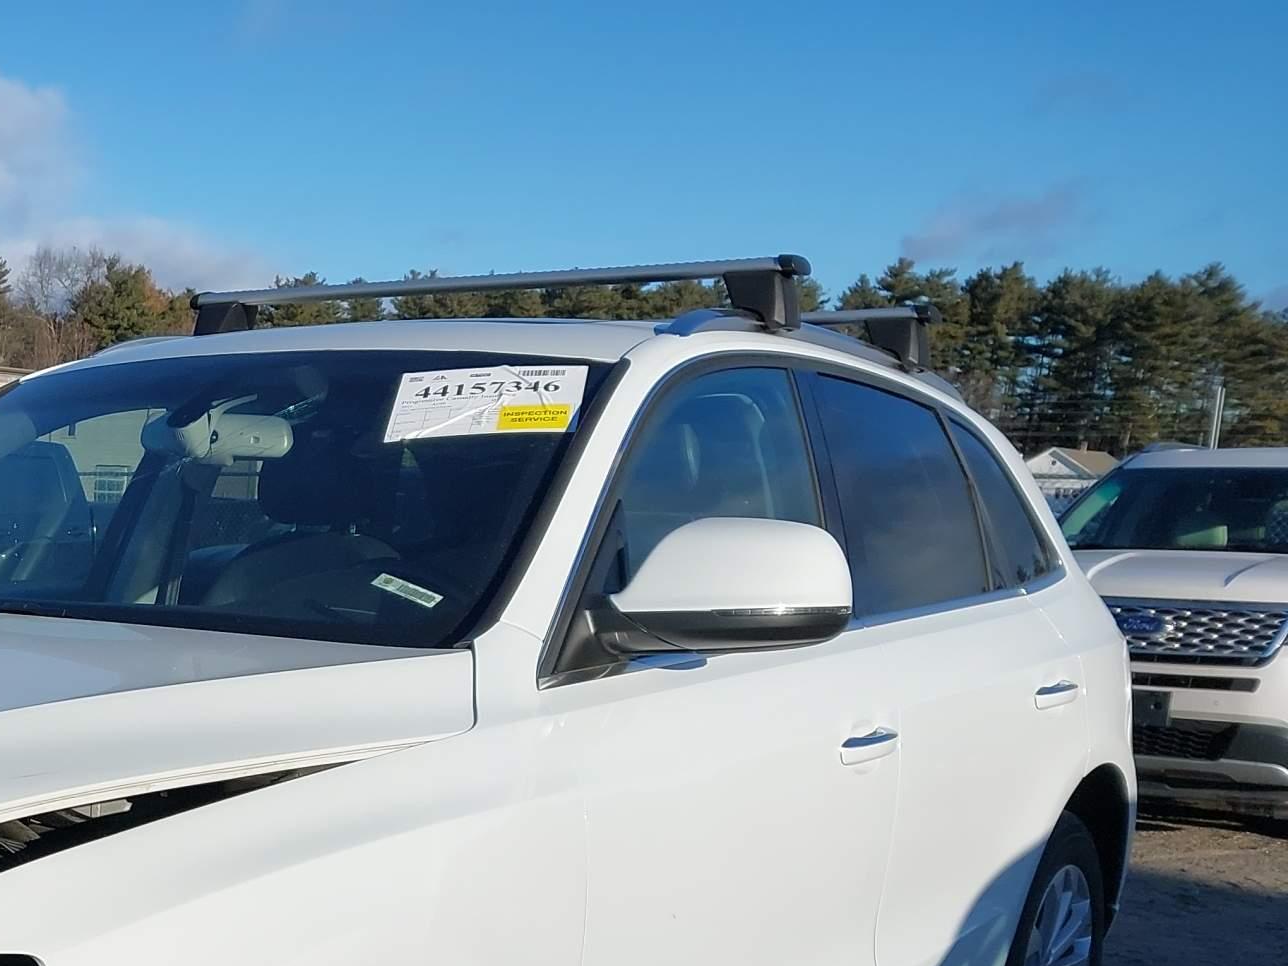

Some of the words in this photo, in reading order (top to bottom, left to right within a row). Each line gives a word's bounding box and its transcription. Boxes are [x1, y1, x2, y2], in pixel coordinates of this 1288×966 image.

[415, 380, 561, 399] 44157346
[503, 409, 568, 417] INSPECTION
[1123, 617, 1158, 632] Ford
